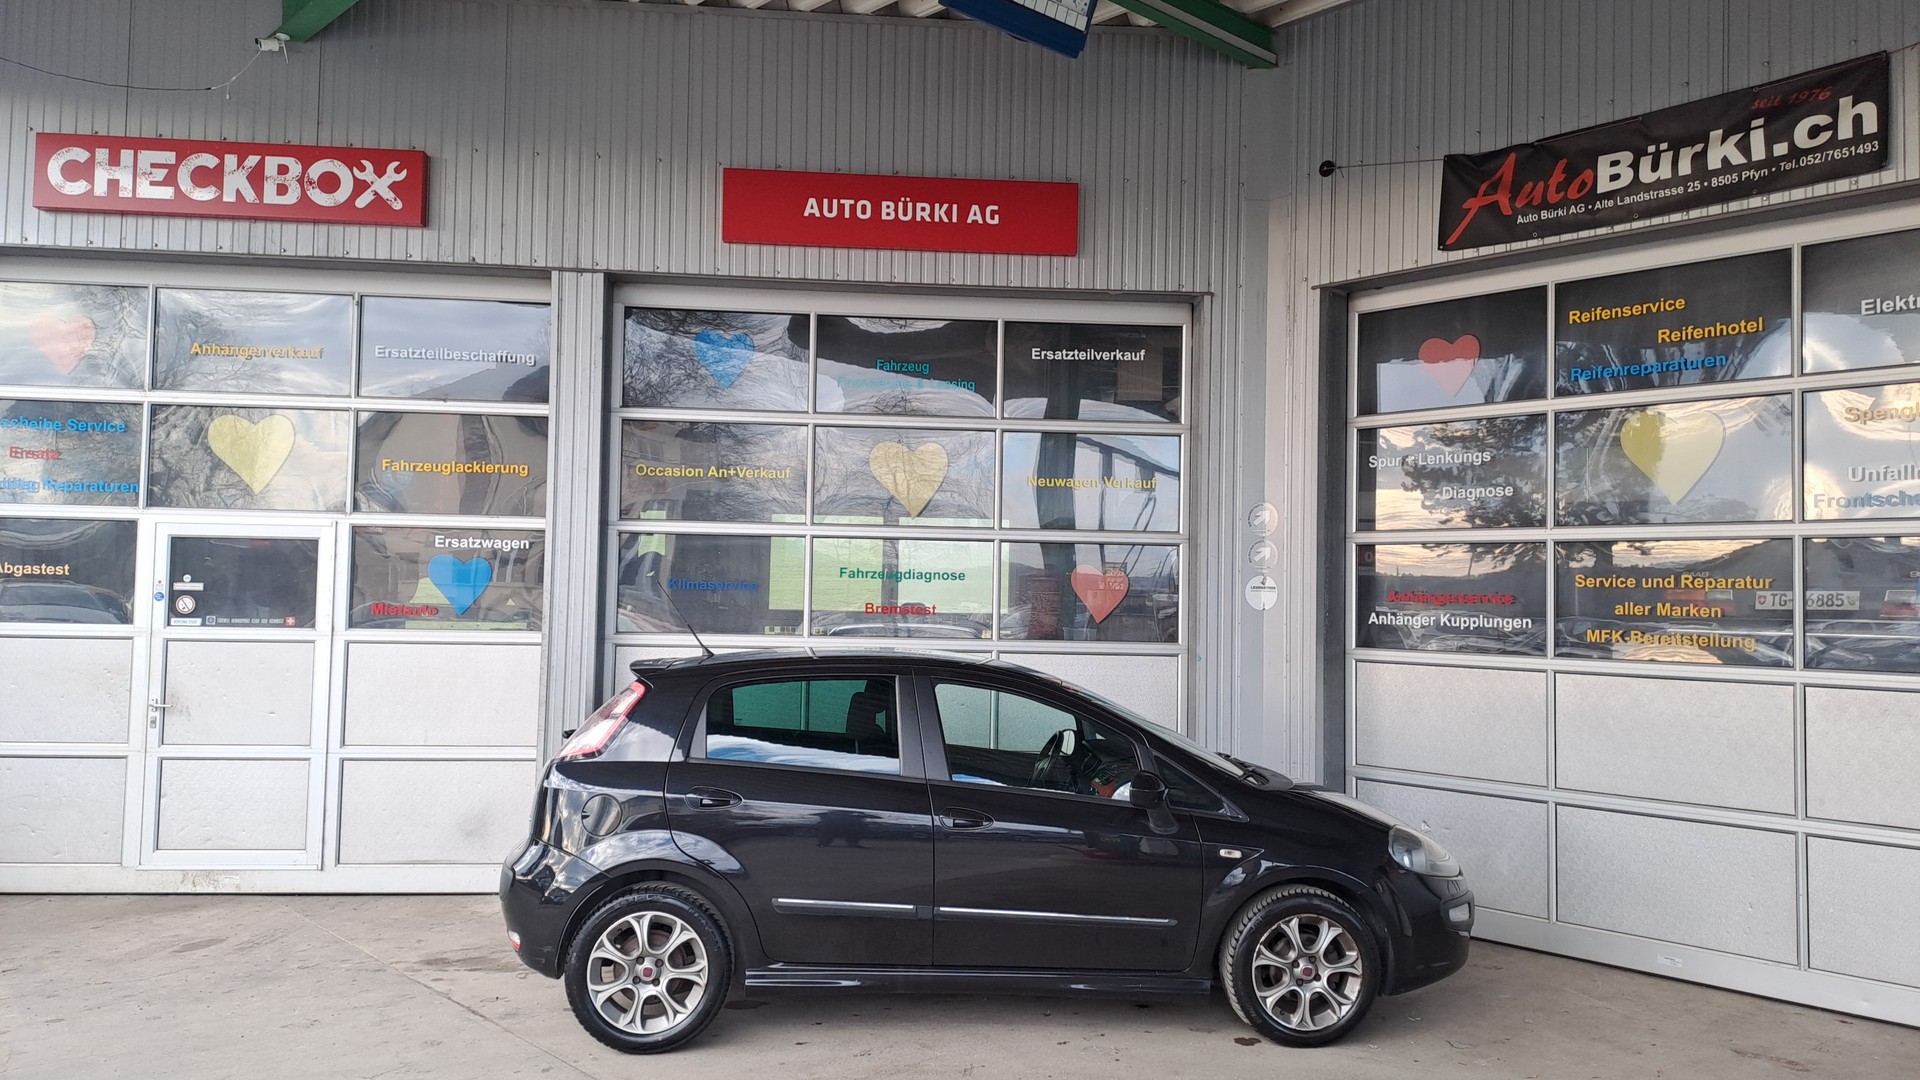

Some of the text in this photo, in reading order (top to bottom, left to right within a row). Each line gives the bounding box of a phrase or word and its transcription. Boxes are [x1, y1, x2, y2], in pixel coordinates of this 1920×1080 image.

[1788, 86, 1834, 105] 1976
[47, 146, 408, 211] CHECKBOX
[1516, 213, 1538, 225] Auto
[1540, 207, 1567, 220] Bürki
[1569, 204, 1585, 215] AG
[1594, 198, 1614, 211] Alte
[1617, 184, 1684, 206] Landstrasse
[1687, 181, 1701, 193] 25
[1711, 173, 1738, 188] 8505
[1741, 167, 1768, 182] Pfyn
[803, 197, 1000, 225] AUTO BÜRKI AG
[1568, 297, 1686, 325] Reifenservice
[1861, 294, 1920, 316] Elekt
[1657, 317, 1764, 344] Reifenhotel
[190, 342, 322, 360] Anhängerverkauf
[375, 345, 536, 367] Ersatzteilbeschaffung
[1031, 348, 1146, 362] Ersatzteilverkauf
[875, 359, 931, 375] Fahrzeug
[1570, 354, 1727, 383] Reifenreparaturen
[67, 418, 126, 433] Service
[382, 459, 529, 477] Fahrzeuglackierung
[1368, 454, 1402, 470] Spur
[1418, 450, 1491, 466] Lenkungs
[635, 464, 793, 479] Occasion An+Verkauf
[42, 478, 139, 494] Reparaturen
[1027, 475, 1157, 490] Neuwagen Verkauf
[1442, 485, 1514, 502] Diagnose
[434, 535, 530, 552] Ersatzwagen
[839, 567, 966, 583] Fahrzeugdiagnose
[1574, 573, 1773, 592] Service und Reparatur
[668, 578, 759, 593] Klimaservice
[370, 602, 437, 618] Mietauto
[865, 602, 938, 616] Bremstest
[1614, 603, 1722, 618] aller Marken
[1368, 612, 1532, 631] Anhänger Kupplungen
[1586, 629, 1756, 652] MFK-Bereitstellung
